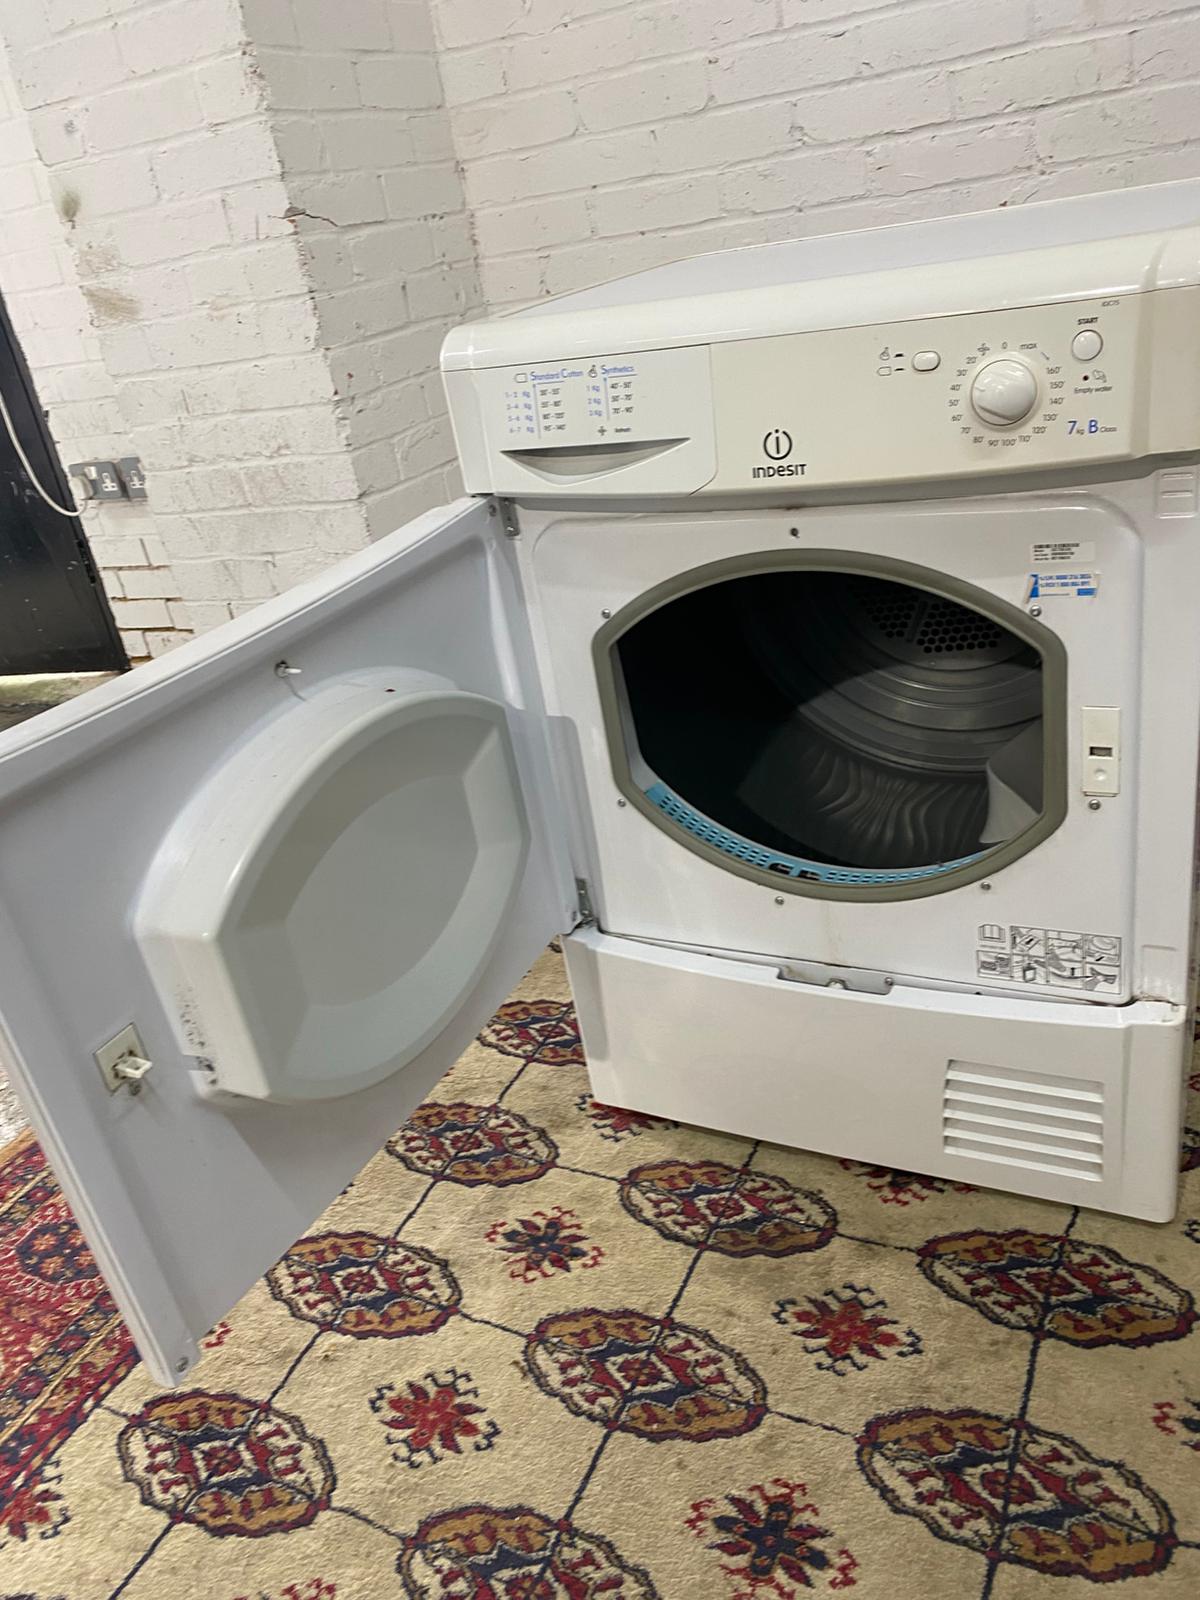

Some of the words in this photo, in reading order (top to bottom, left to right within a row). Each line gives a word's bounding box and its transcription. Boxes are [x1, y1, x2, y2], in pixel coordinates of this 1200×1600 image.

[1078, 317, 1099, 325] START
[529, 371, 560, 381] Standard
[561, 368, 584, 379] Cotton
[601, 364, 635, 375] Synthetics
[1074, 386, 1094, 395] Empty
[1088, 419, 1099, 434] B
